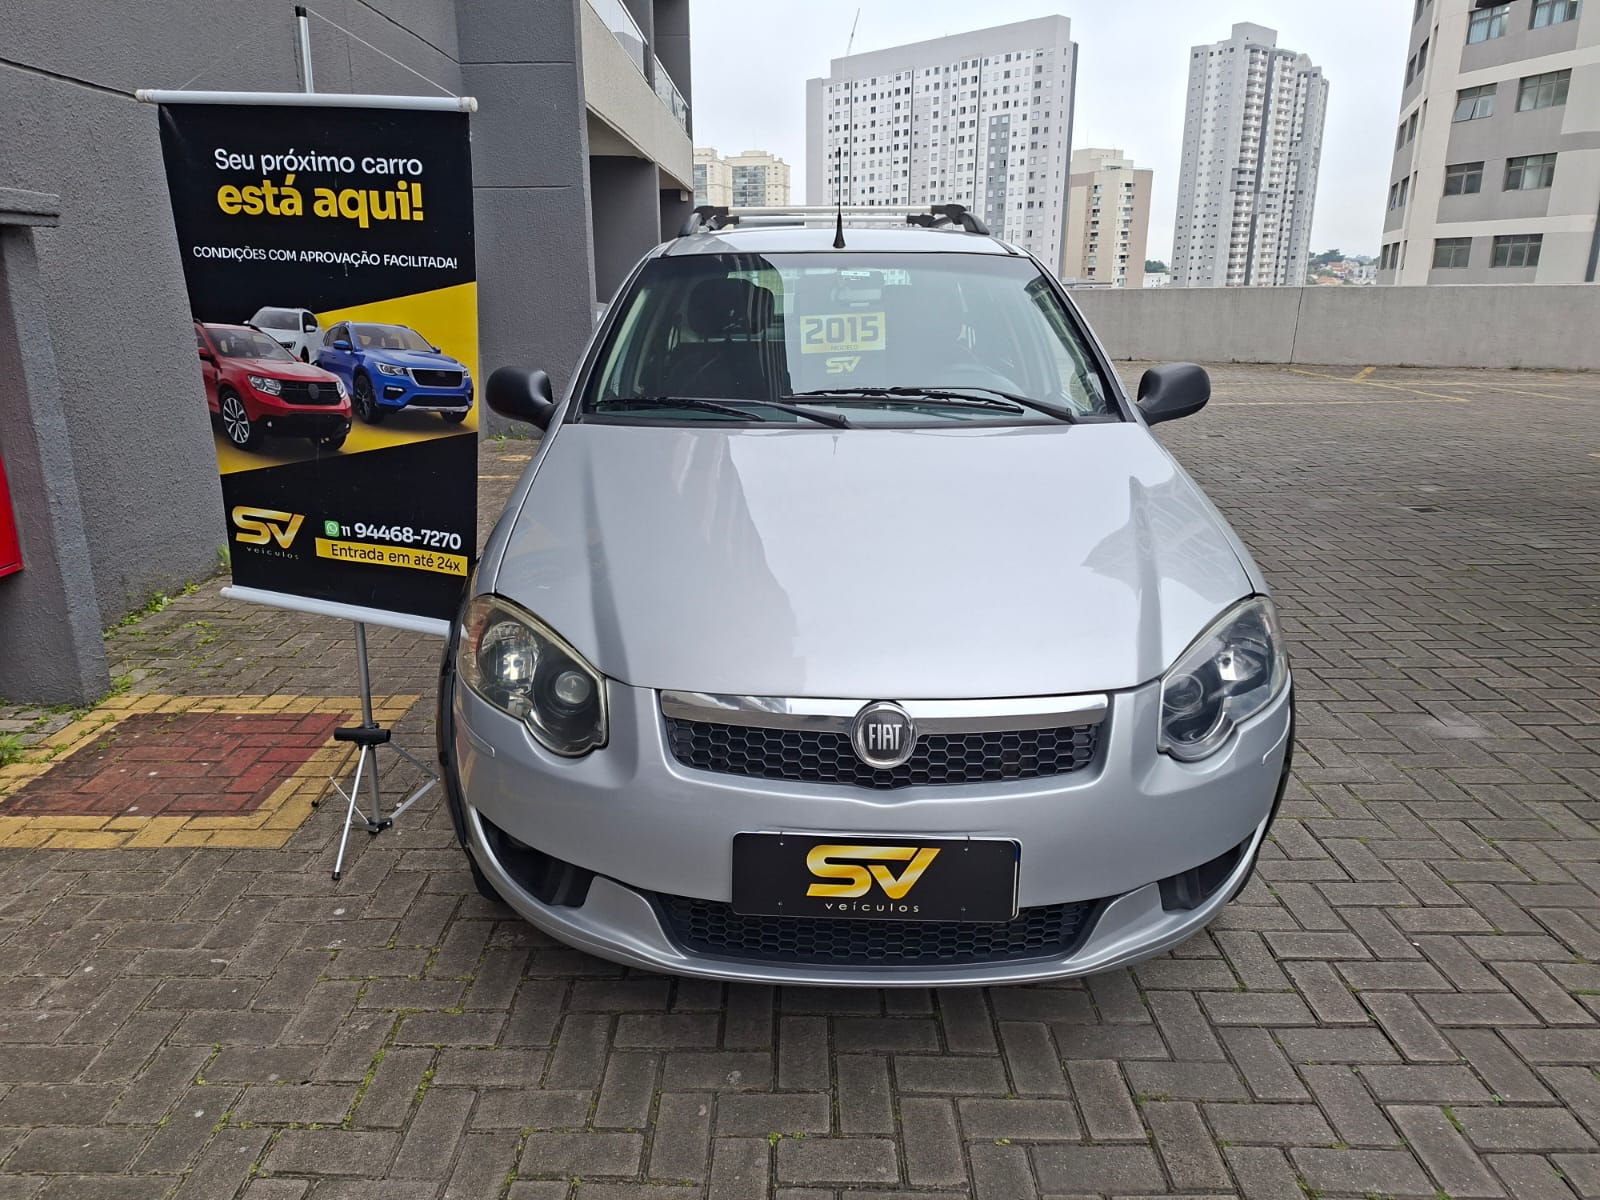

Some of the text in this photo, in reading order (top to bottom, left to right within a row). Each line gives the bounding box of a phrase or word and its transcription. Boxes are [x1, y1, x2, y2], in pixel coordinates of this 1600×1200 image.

[214, 148, 423, 176] Seu próximo carro
[217, 174, 424, 228] está aqui!
[193, 245, 458, 270] CONDIÇÕES COM APROVAÇÃO FACILITADA!
[805, 317, 879, 344] 2015
[826, 356, 860, 373] SV
[232, 505, 305, 549] SV
[340, 522, 462, 550] 11 94468-7270
[331, 544, 461, 573] Entrada em até 24x
[868, 723, 903, 750] FIAT
[806, 844, 941, 899] SV
[825, 901, 919, 913] veículos
